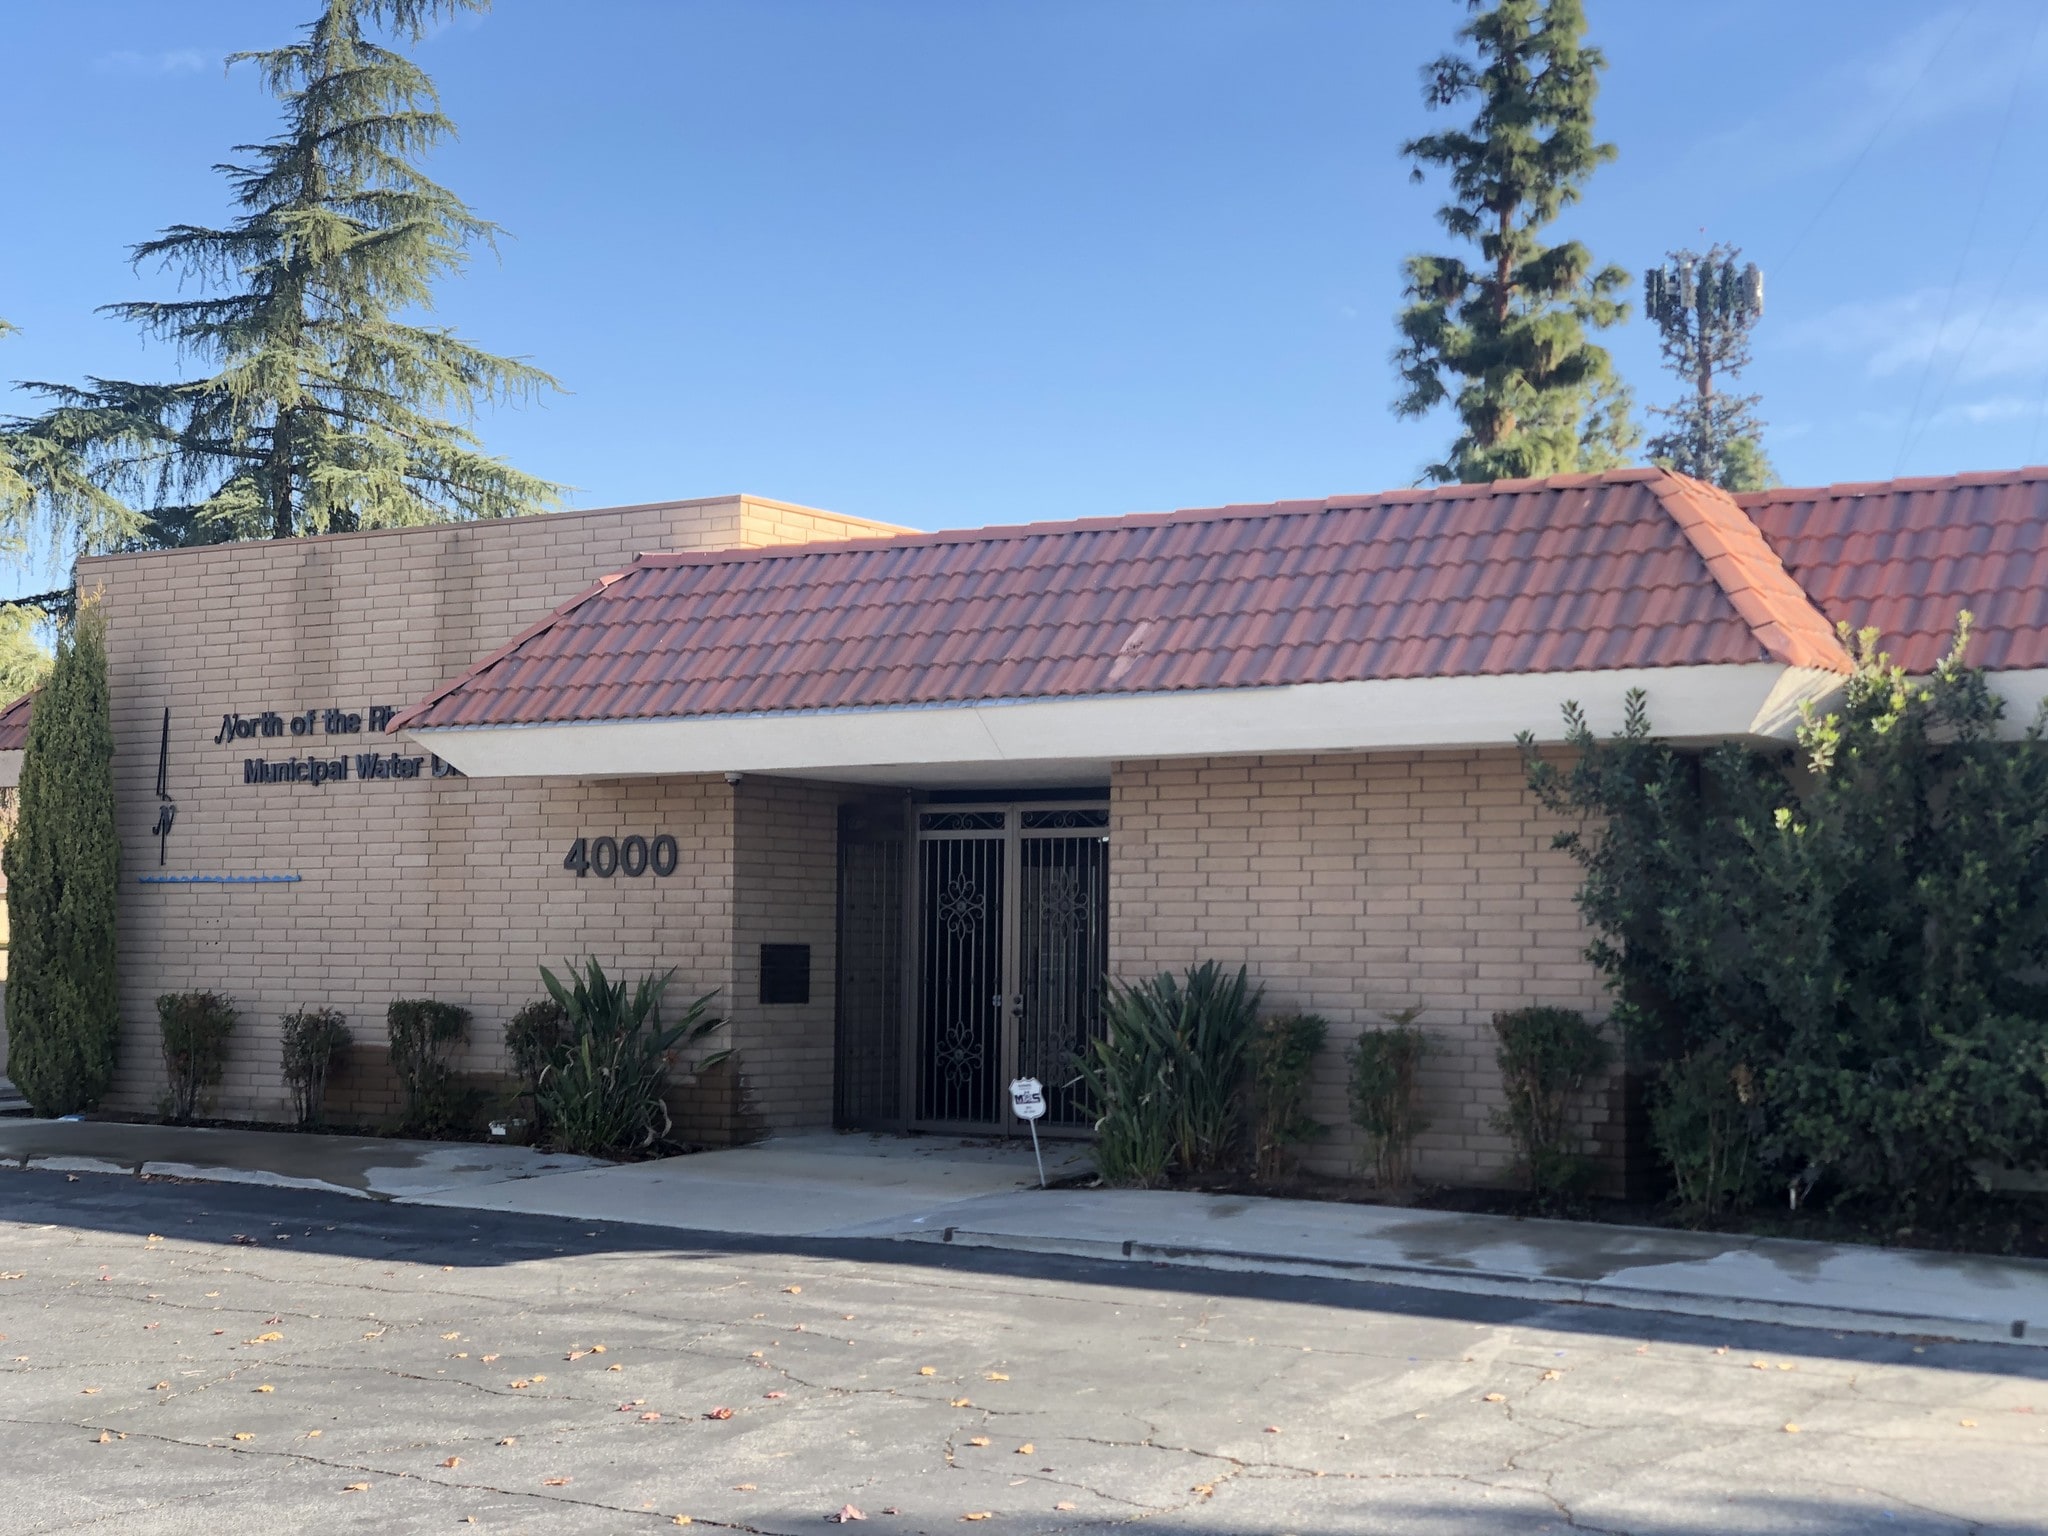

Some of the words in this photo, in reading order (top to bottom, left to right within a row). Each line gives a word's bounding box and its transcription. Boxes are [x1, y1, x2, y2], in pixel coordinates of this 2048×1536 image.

[214, 711, 284, 744] North
[290, 709, 316, 736] of
[322, 708, 361, 734] the
[243, 755, 348, 786] Municipal
[355, 752, 424, 779] Water
[563, 834, 678, 878] 4000
